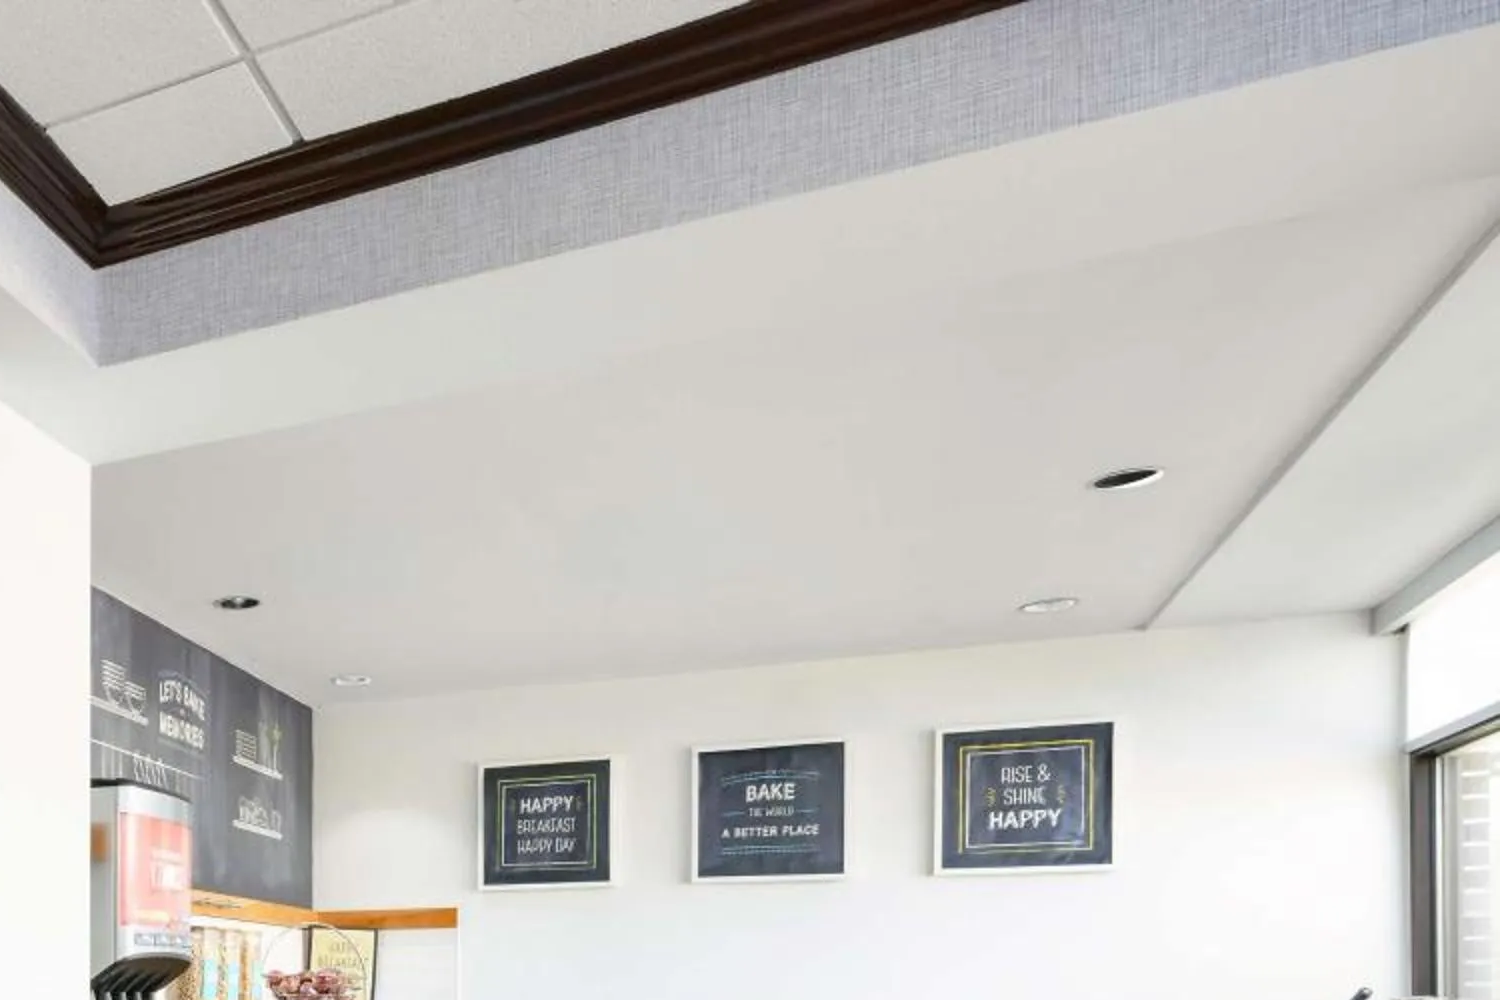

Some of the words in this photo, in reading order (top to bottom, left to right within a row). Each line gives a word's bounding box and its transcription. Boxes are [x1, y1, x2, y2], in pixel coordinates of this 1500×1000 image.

[1001, 765, 1033, 784] RISE
[1037, 763, 1051, 782] &
[745, 782, 796, 803] BAKE
[1003, 786, 1046, 806] SHINE
[520, 795, 574, 814] HAPPY
[517, 817, 576, 835] BREAKFAST
[988, 808, 1062, 831] HAPPY
[720, 828, 731, 839] A
[733, 826, 778, 839] BETTER
[781, 824, 820, 837] PLACE
[517, 838, 553, 855] HAPPY
[555, 837, 577, 853] DAY
